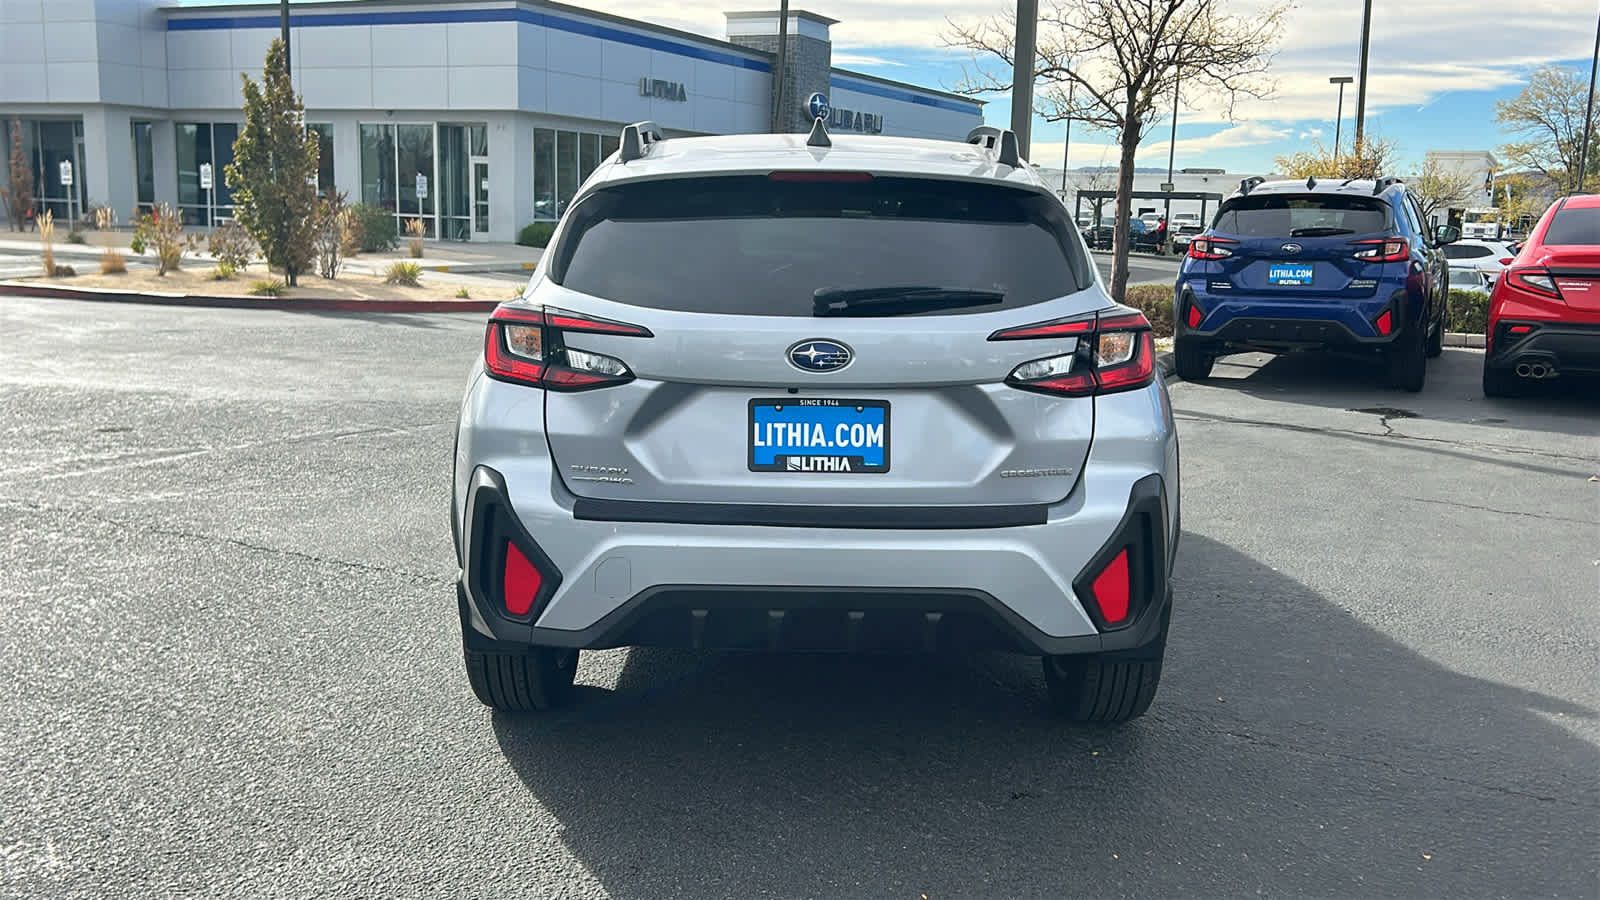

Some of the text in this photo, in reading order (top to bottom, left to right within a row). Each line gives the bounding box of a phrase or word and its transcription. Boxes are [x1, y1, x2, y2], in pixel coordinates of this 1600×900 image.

[639, 77, 687, 102] LITHIA
[1269, 269, 1312, 278] LITHIA.COM
[754, 422, 884, 447] LITHIA.COM
[801, 456, 852, 471] LITHIA
